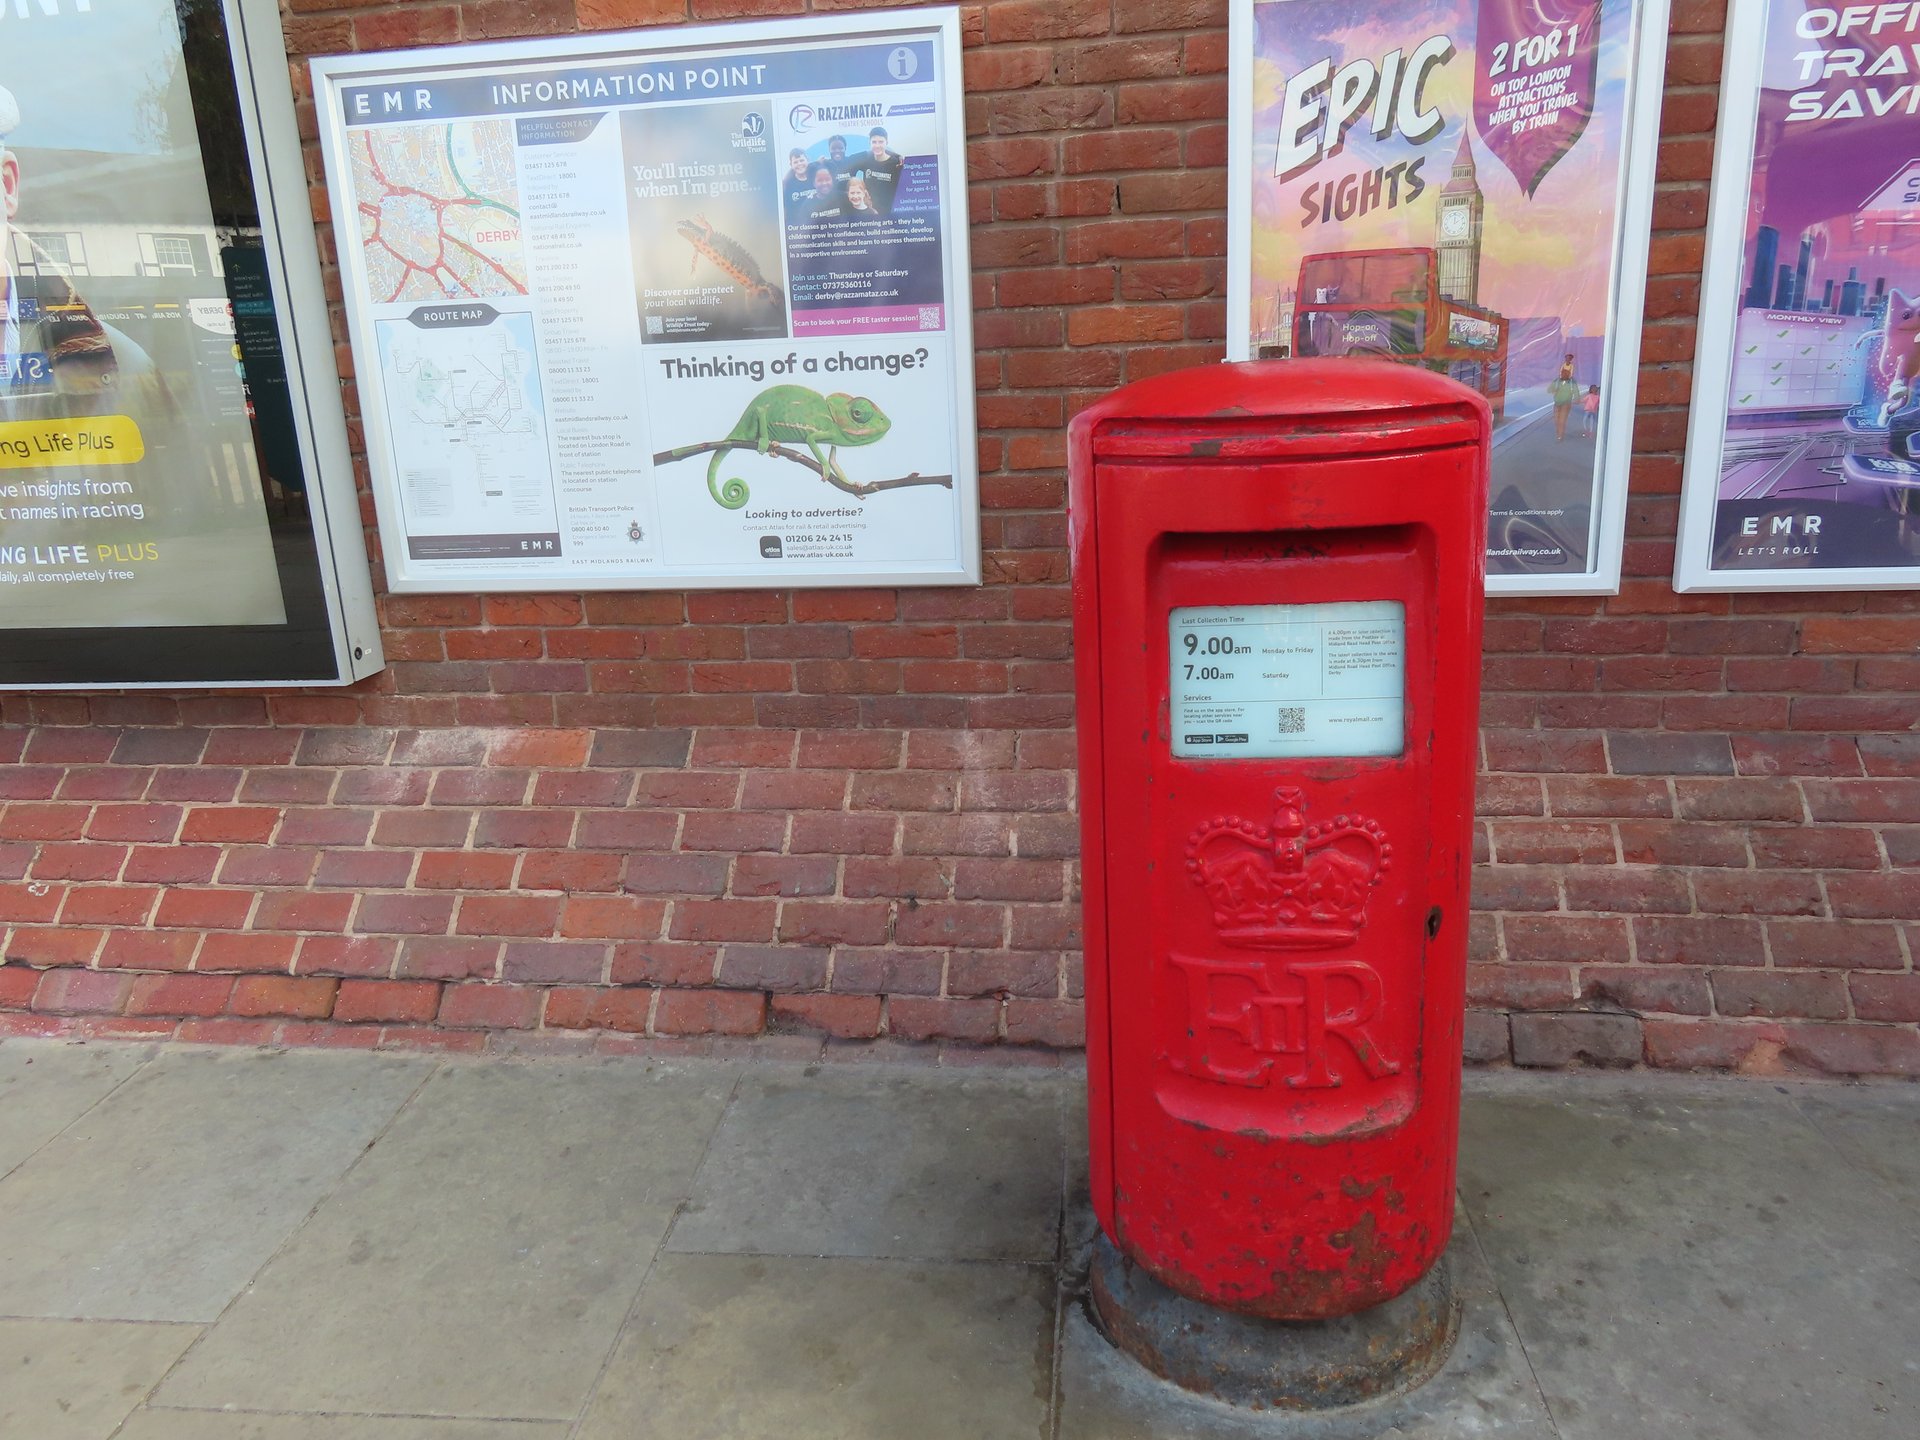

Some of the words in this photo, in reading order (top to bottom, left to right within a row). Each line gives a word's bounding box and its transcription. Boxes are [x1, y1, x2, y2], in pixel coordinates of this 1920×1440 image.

[1488, 42, 1509, 78] 2
[1512, 30, 1563, 73] FOR
[1567, 24, 1579, 56] 1
[492, 72, 675, 105] INFORMATION
[685, 64, 766, 90] POINT
[1490, 82, 1506, 97] ON
[1507, 75, 1528, 93] TOP
[1529, 64, 1572, 87] LONDON
[1498, 80, 1566, 110] ATTRACTIONS
[818, 104, 882, 122] RAZZAMATAZ
[1273, 34, 1456, 181] EPIC
[1488, 108, 1518, 126] WHEN
[1520, 102, 1540, 120] YOU
[1542, 92, 1578, 114] TRAVEL
[520, 123, 554, 132] HELPFUL
[556, 120, 592, 128] CONTACT
[1511, 120, 1528, 134] BY
[1529, 111, 1559, 130] TRAIN
[521, 130, 574, 140] INFORMATION
[732, 138, 766, 148] Wildlife
[632, 162, 676, 181] You'll
[678, 162, 716, 178] miss
[718, 162, 743, 176] me
[634, 183, 678, 199] when
[680, 180, 707, 196] I'm
[710, 179, 761, 197] gone...
[1300, 156, 1426, 229] SIGHTS
[850, 220, 882, 228] performing
[476, 230, 519, 243] DERBY
[800, 250, 830, 258] supportive
[829, 272, 864, 280] Thursdays
[874, 269, 908, 278] Saturdays
[644, 288, 682, 297] Discover
[684, 287, 700, 296] and
[702, 286, 734, 296] protect
[822, 281, 872, 289] 07375360116
[644, 300, 664, 309] your
[666, 298, 686, 306] local
[688, 296, 722, 306] wildlife.
[815, 290, 899, 300] derby@razzamataz.co.uk
[424, 311, 459, 321] ROUTE
[462, 310, 483, 320] MAP
[892, 314, 918, 322] session!
[1766, 313, 1816, 324] MONTHLY
[1342, 333, 1377, 343] Hop-off
[660, 356, 764, 382] Thinking
[770, 353, 797, 374] of
[803, 358, 818, 373] a
[824, 348, 929, 376] change?
[34, 434, 73, 452] Life
[78, 432, 114, 450] Plus
[22, 480, 80, 500] insights
[84, 479, 133, 495] from
[10, 506, 58, 520] names
[62, 503, 77, 518] in
[82, 501, 144, 519] racing
[746, 510, 788, 520] Looking
[791, 510, 802, 518] to
[806, 508, 863, 518] advertise?
[830, 522, 866, 530] advertising
[1741, 516, 1822, 536] EMR
[521, 541, 553, 550] EMR
[1738, 547, 1776, 556] LET'S
[1783, 546, 1819, 554] ROLL
[34, 546, 90, 564] LIFE
[96, 543, 159, 562] PLUS
[22, 571, 36, 582] all
[38, 570, 105, 584] completely
[108, 569, 134, 580] free
[1184, 634, 1252, 656] 9.00am
[1184, 664, 1234, 680] 7.00am
